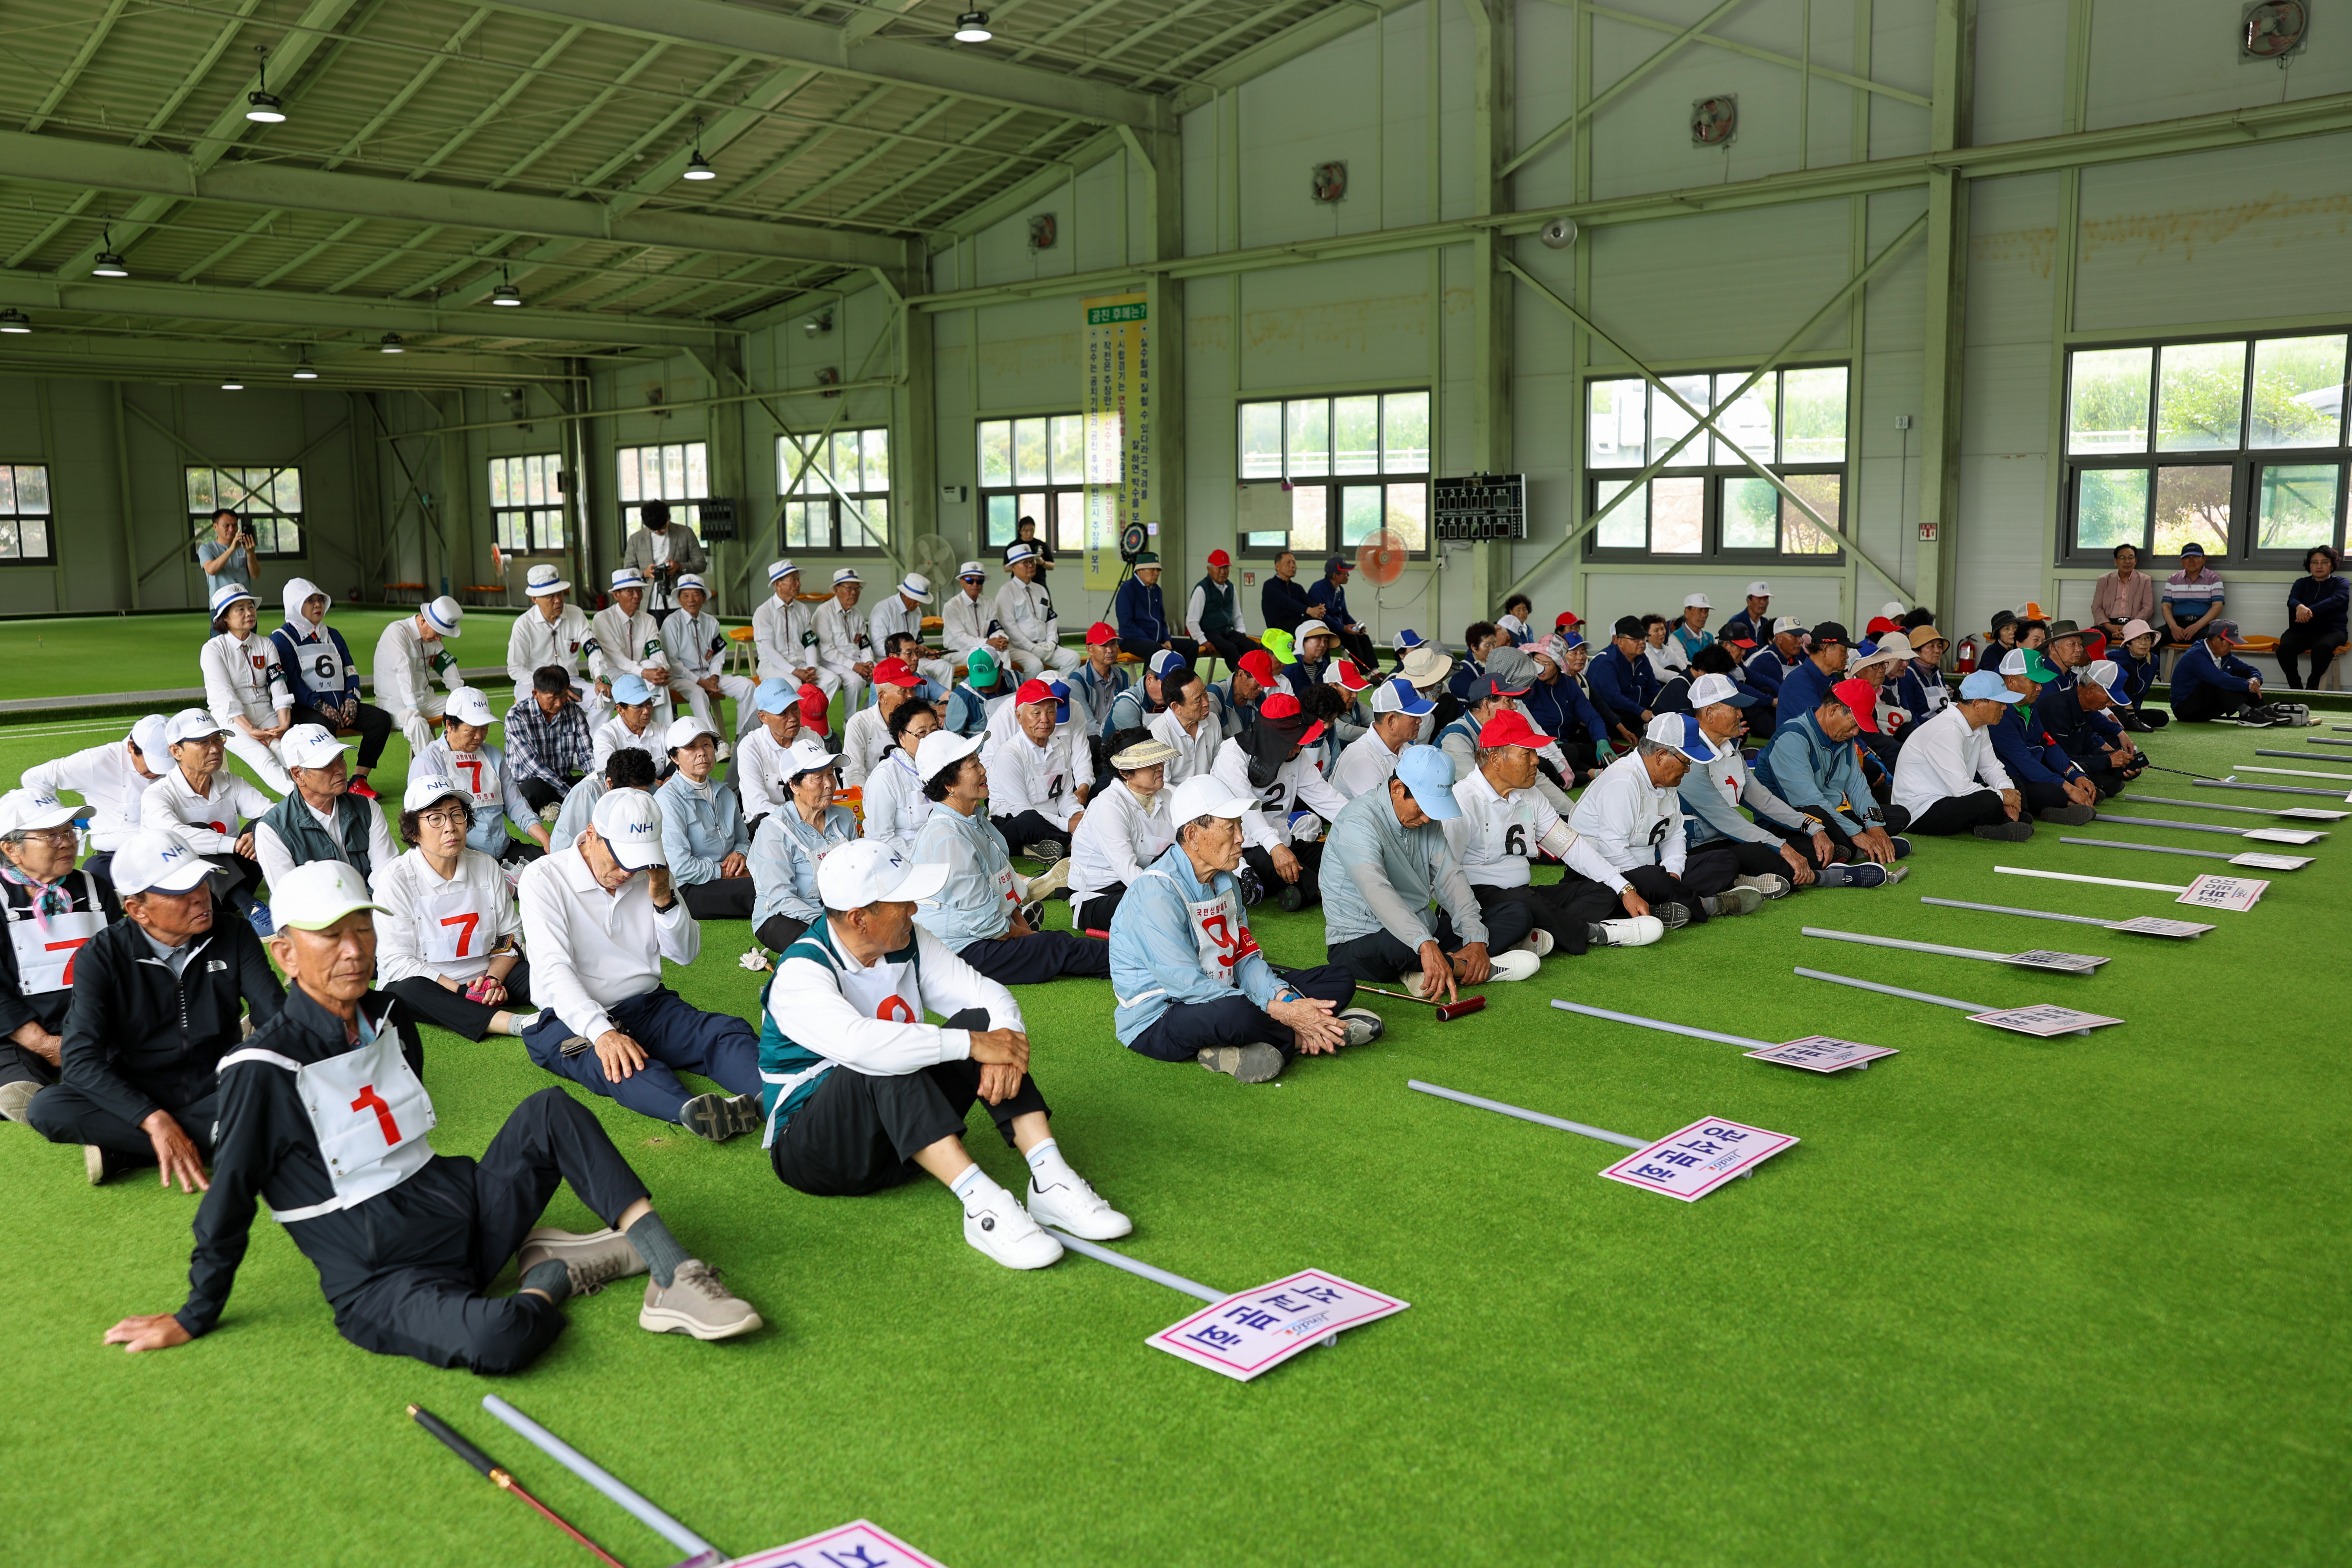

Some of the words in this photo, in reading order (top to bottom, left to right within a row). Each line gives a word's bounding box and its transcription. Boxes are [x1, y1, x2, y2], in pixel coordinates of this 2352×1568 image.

[1092, 309, 1109, 323] 공친
[1112, 305, 1146, 319] 후에는?
[1092, 555, 1099, 574] 보기
[315, 655, 335, 678] 6
[196, 715, 212, 724] NH
[1887, 712, 1904, 735] 9
[309, 732, 330, 746] NH
[427, 781, 450, 790] NH
[456, 761, 483, 793] 7
[35, 795, 58, 808] NH
[1262, 783, 1285, 812] 2
[630, 822, 653, 834] NH
[1648, 818, 1670, 846] 6
[1505, 824, 1527, 856] 6
[161, 844, 187, 863] NH
[1197, 900, 1228, 917] 국민생활체육
[440, 913, 479, 958] 7
[1201, 914, 1238, 967] 9
[45, 938, 90, 986] 7
[1767, 1040, 1857, 1062] 군내분회
[350, 1084, 402, 1147] 1
[1627, 1127, 1749, 1183] 광석분회
[1713, 1151, 1742, 1168] Jindo
[1185, 1286, 1343, 1351] 석교분회
[1292, 1312, 1330, 1332] Jindo
